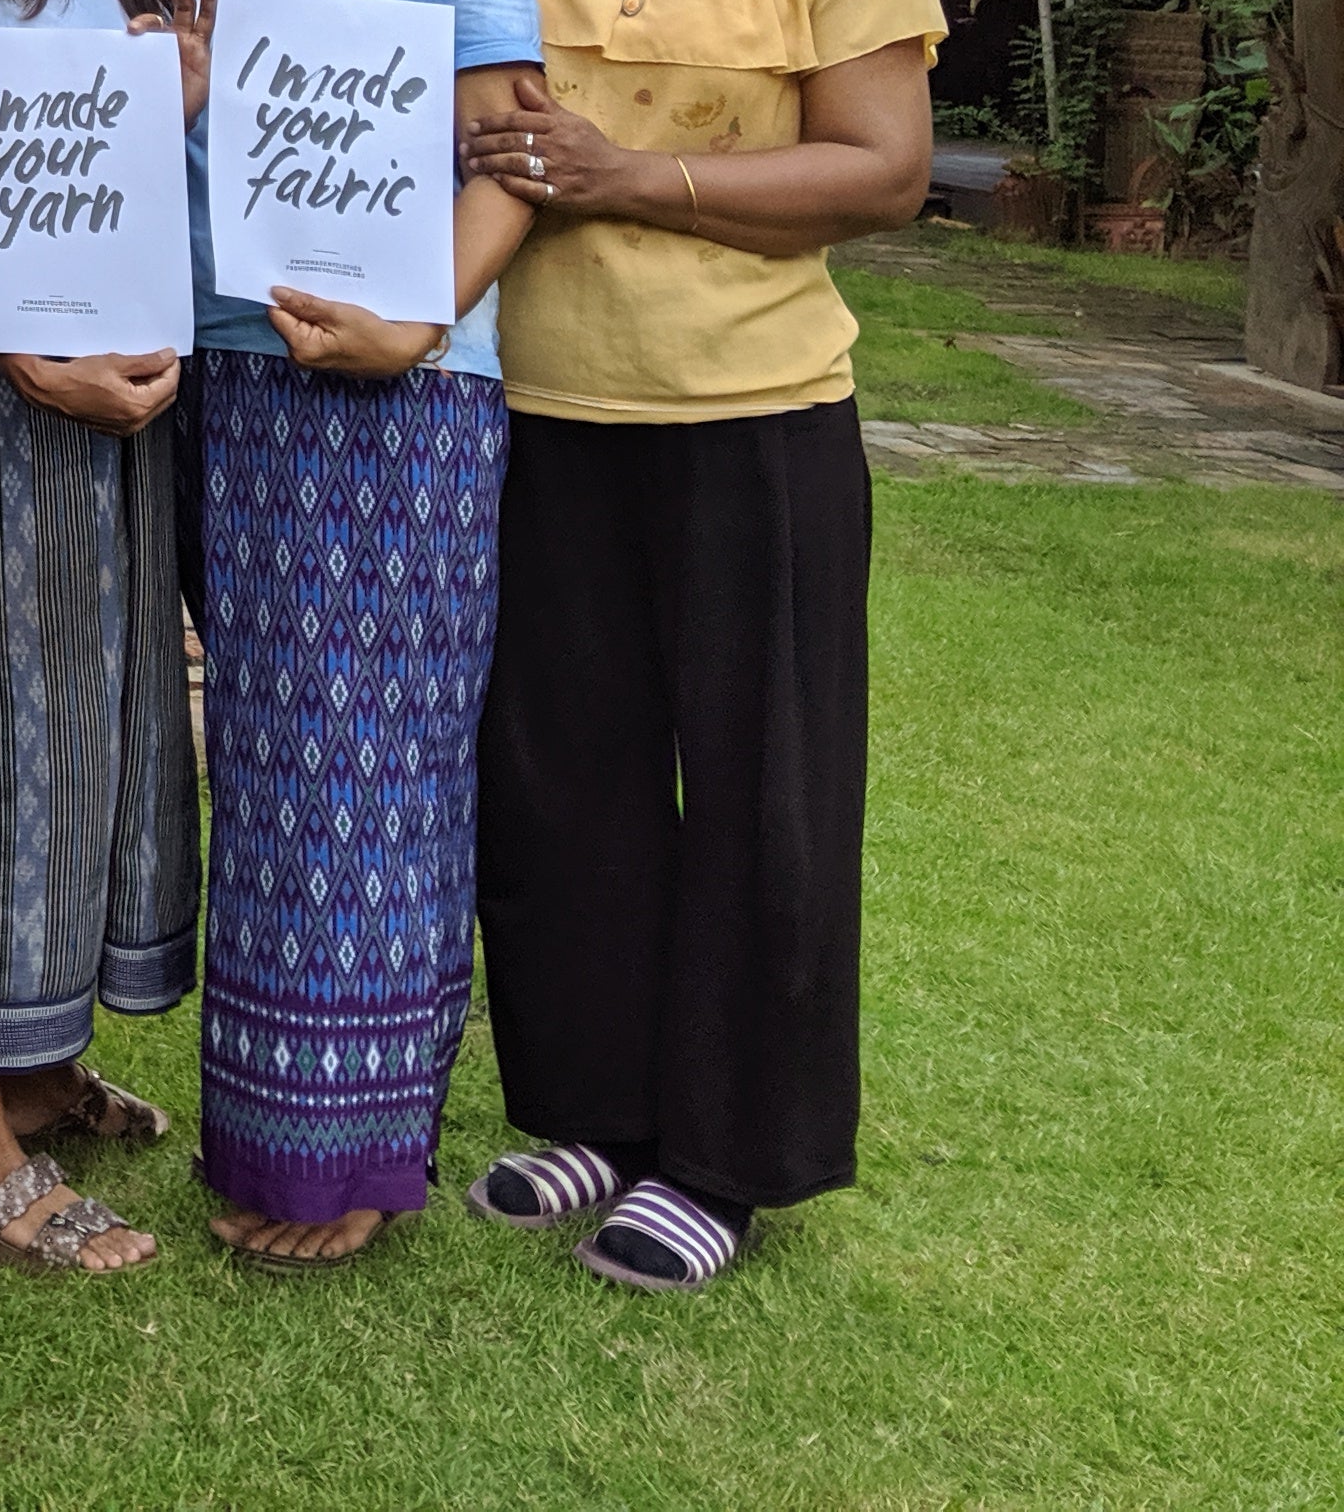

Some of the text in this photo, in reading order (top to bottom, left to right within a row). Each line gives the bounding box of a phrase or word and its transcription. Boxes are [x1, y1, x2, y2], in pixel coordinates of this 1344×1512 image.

[227, 37, 427, 114] I made
[248, 103, 374, 159] your
[244, 147, 416, 219] fabric
